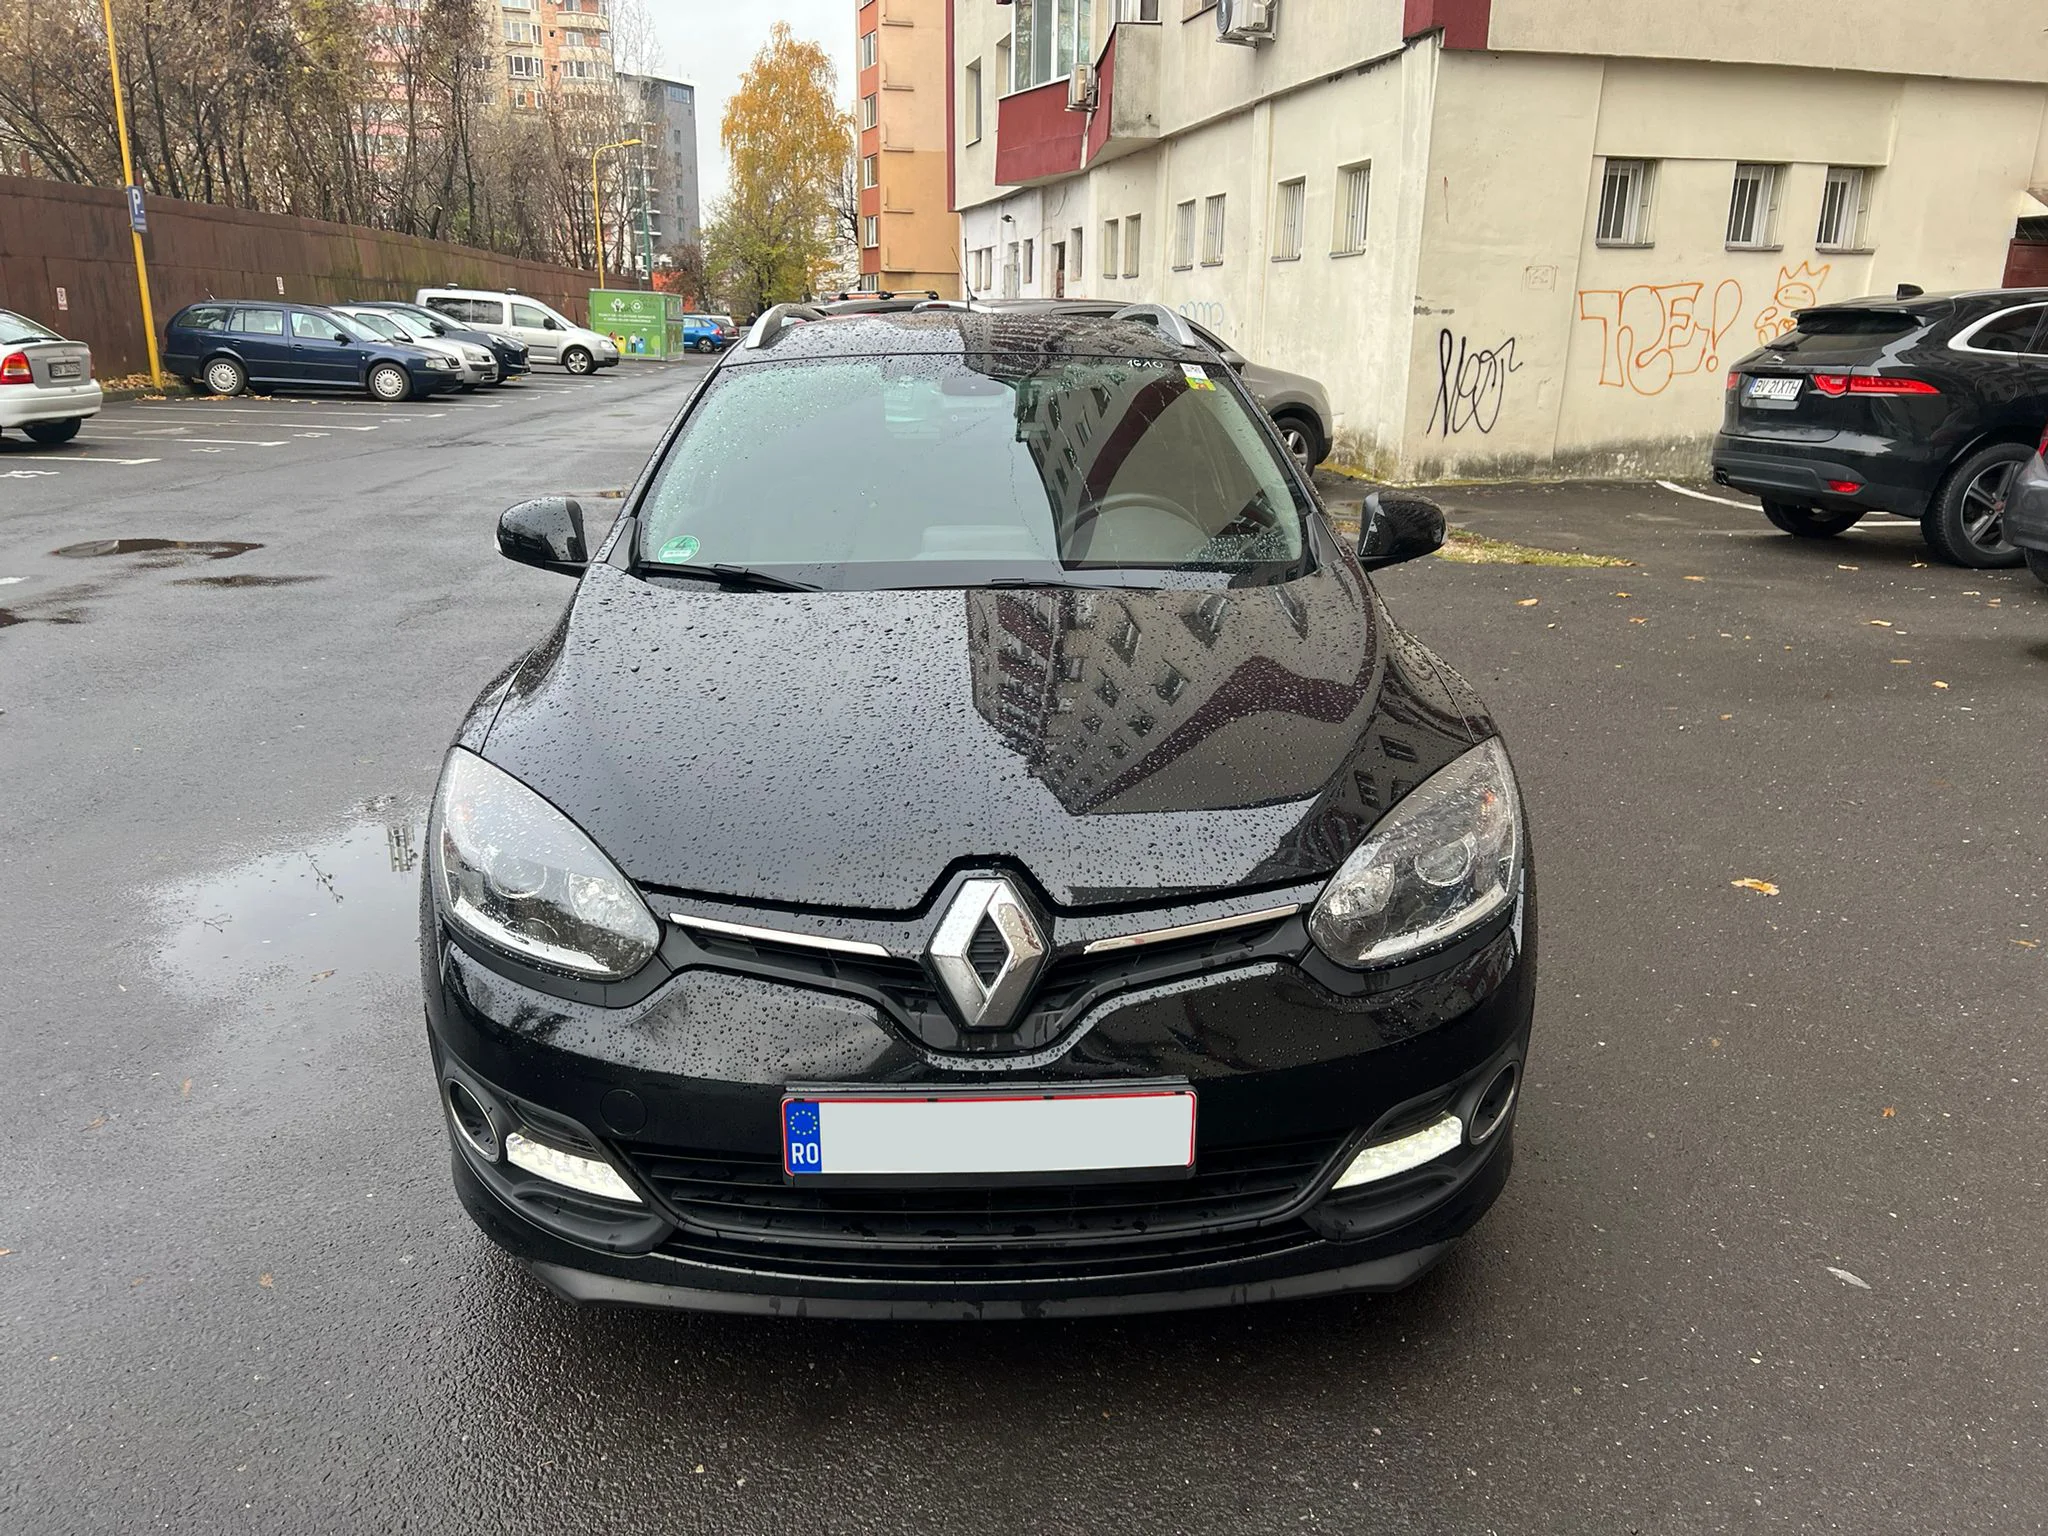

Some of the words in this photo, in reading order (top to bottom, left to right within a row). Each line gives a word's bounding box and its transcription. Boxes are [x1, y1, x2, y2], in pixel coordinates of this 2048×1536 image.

[131, 189, 141, 215] P
[1755, 380, 1769, 393] BV
[1778, 380, 1800, 394] XTH
[791, 1142, 820, 1165] RO
